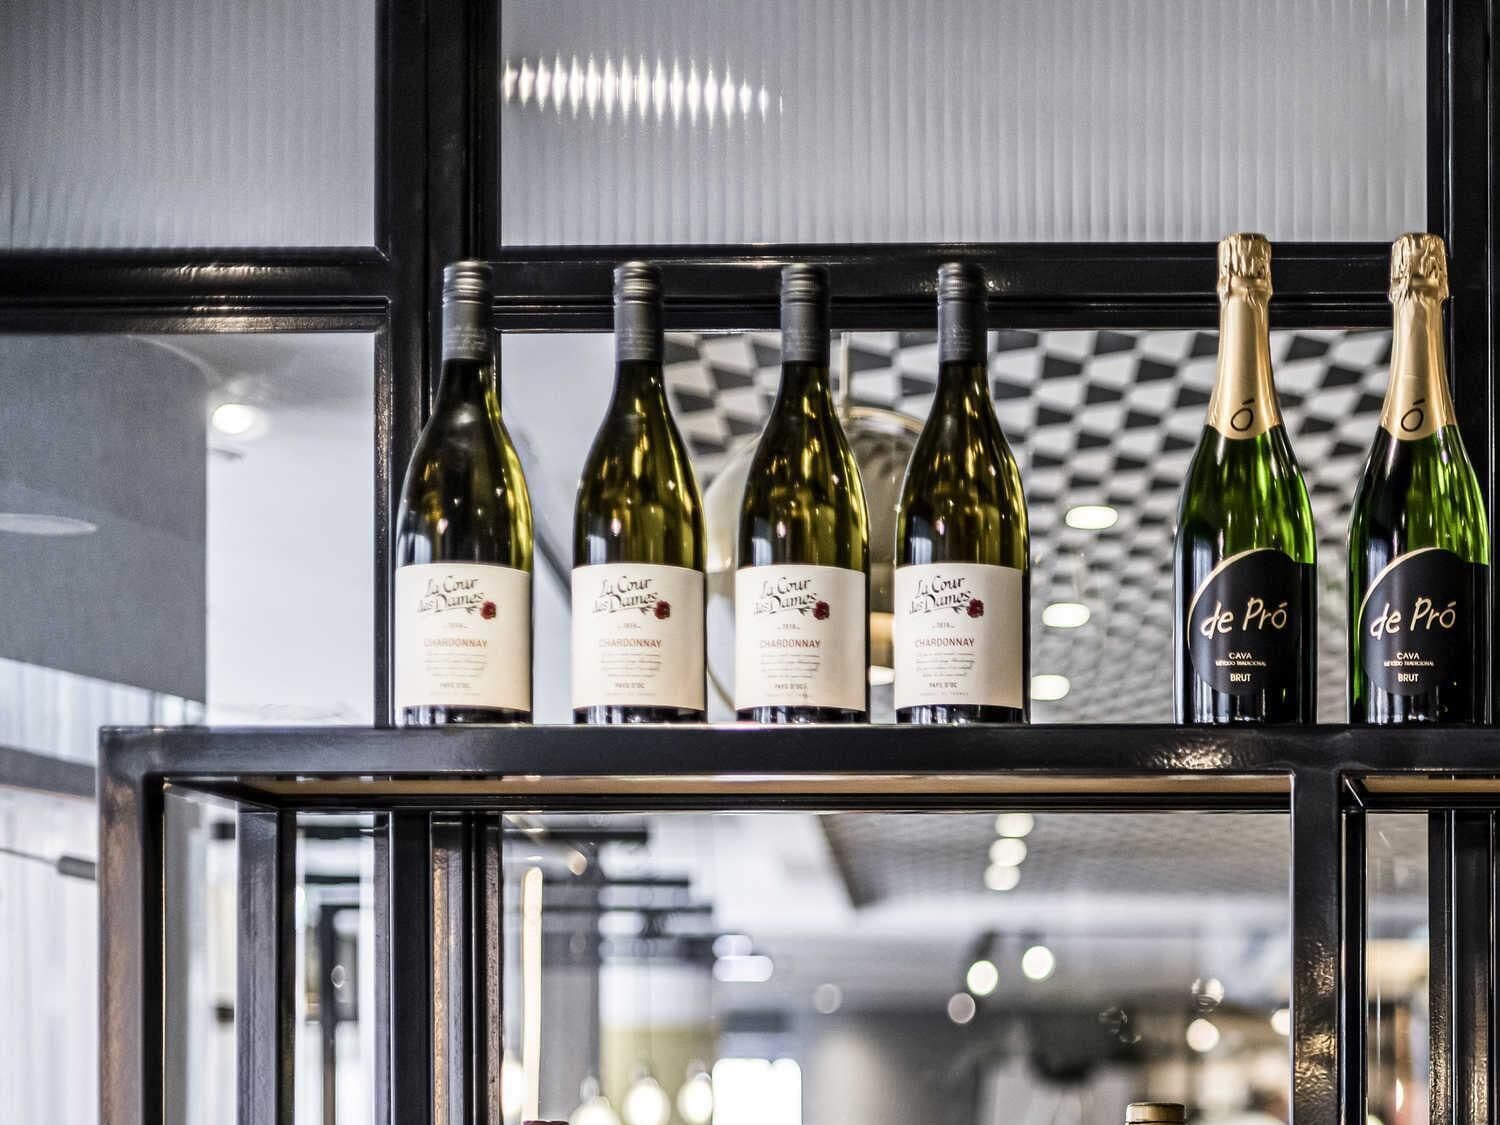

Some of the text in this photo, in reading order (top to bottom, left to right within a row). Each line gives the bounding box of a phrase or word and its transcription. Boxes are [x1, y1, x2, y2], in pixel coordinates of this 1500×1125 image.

[1200, 597, 1288, 640] de Pró
[1370, 597, 1456, 640] de Pró
[915, 638, 975, 648] CHARDONNAY
[1228, 652, 1252, 660] CAVA
[1396, 652, 1420, 660] CAVA
[1230, 673, 1251, 682] BRUT
[1398, 673, 1419, 682] BRUT
